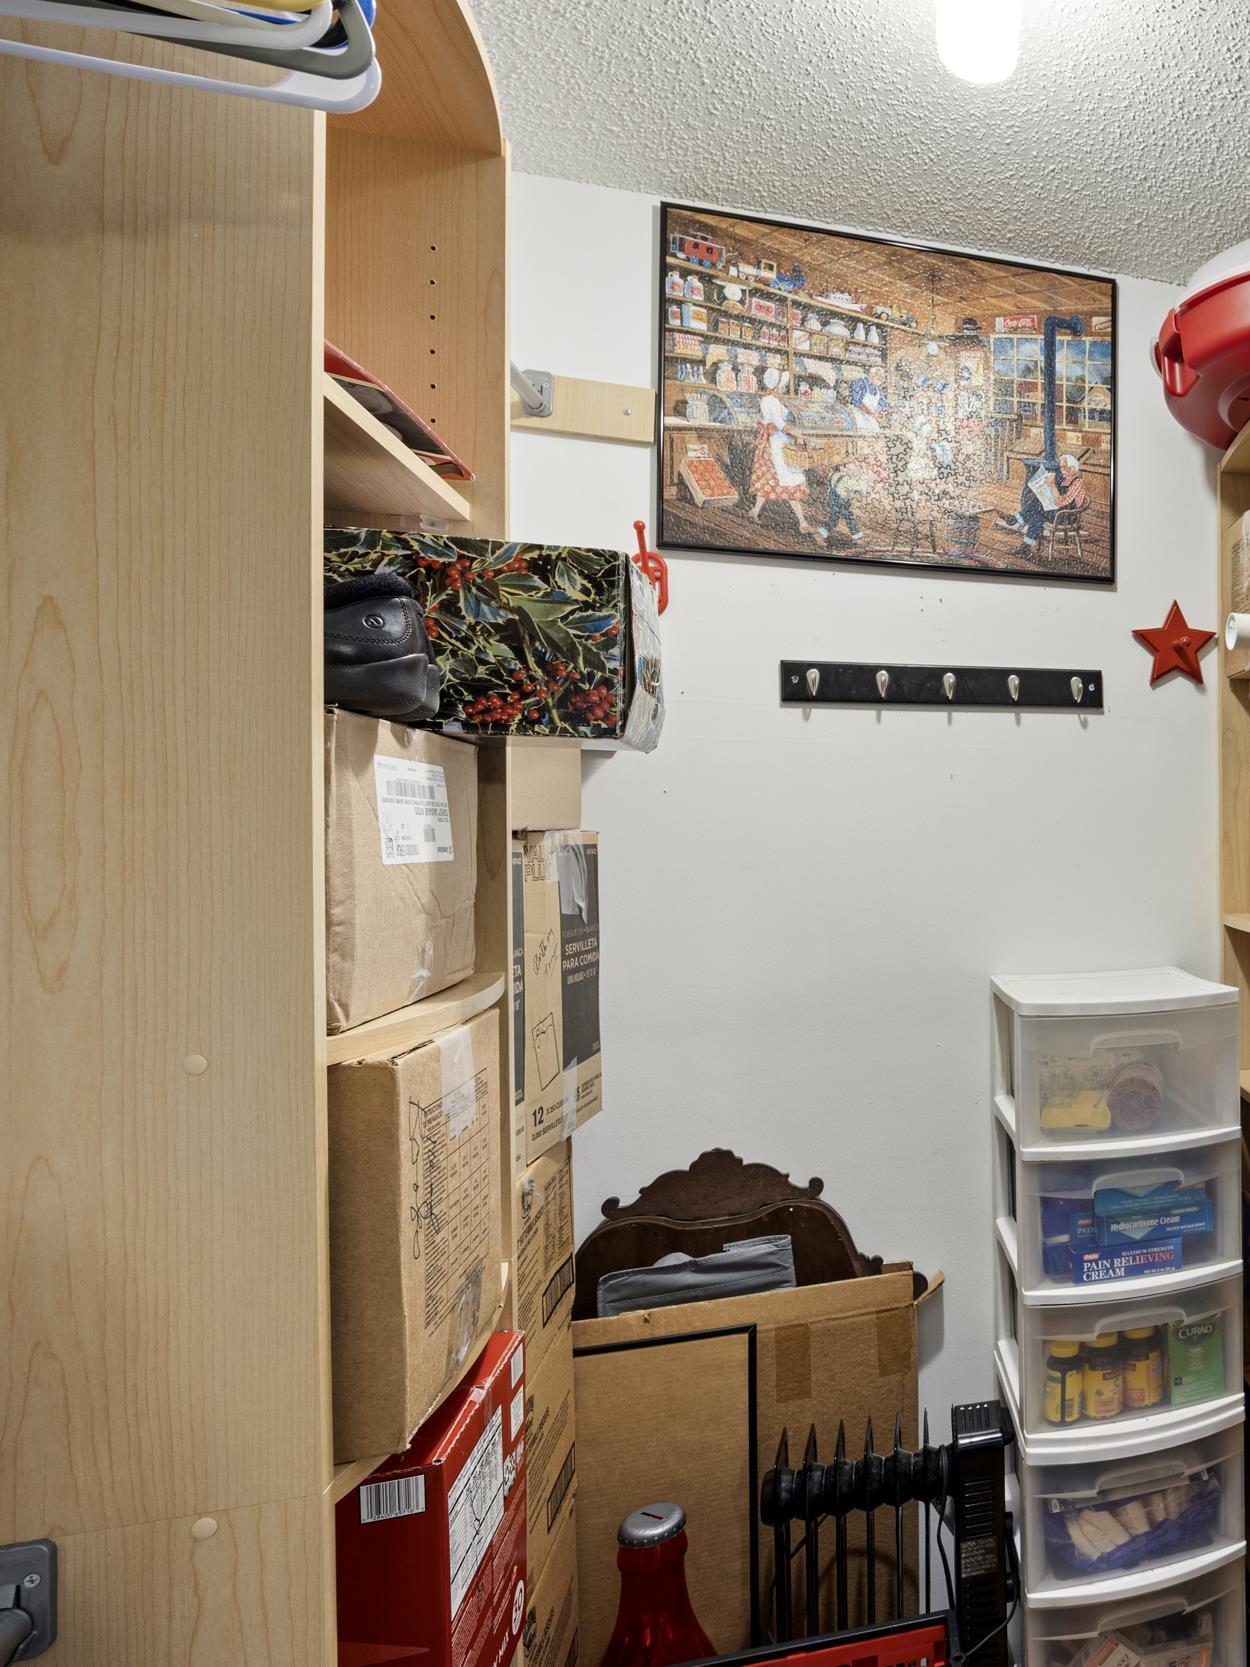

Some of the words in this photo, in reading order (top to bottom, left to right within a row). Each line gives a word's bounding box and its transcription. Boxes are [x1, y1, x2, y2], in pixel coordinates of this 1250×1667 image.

[565, 938, 598, 955] SERVILLETA
[562, 955, 578, 972] PARA
[579, 951, 600, 967] COMIDA
[532, 1105, 544, 1127] 12
[1110, 1219, 1158, 1232] Hydrocortisone
[1160, 1215, 1180, 1226] Cream
[1122, 1249, 1147, 1257] MAXIMUM
[1148, 1245, 1174, 1253] STRENGTH
[1083, 1259, 1111, 1272] PAIN
[1113, 1251, 1174, 1268] RELIEVING
[1083, 1268, 1125, 1282] CREAM
[1178, 1324, 1213, 1339] CURAD
